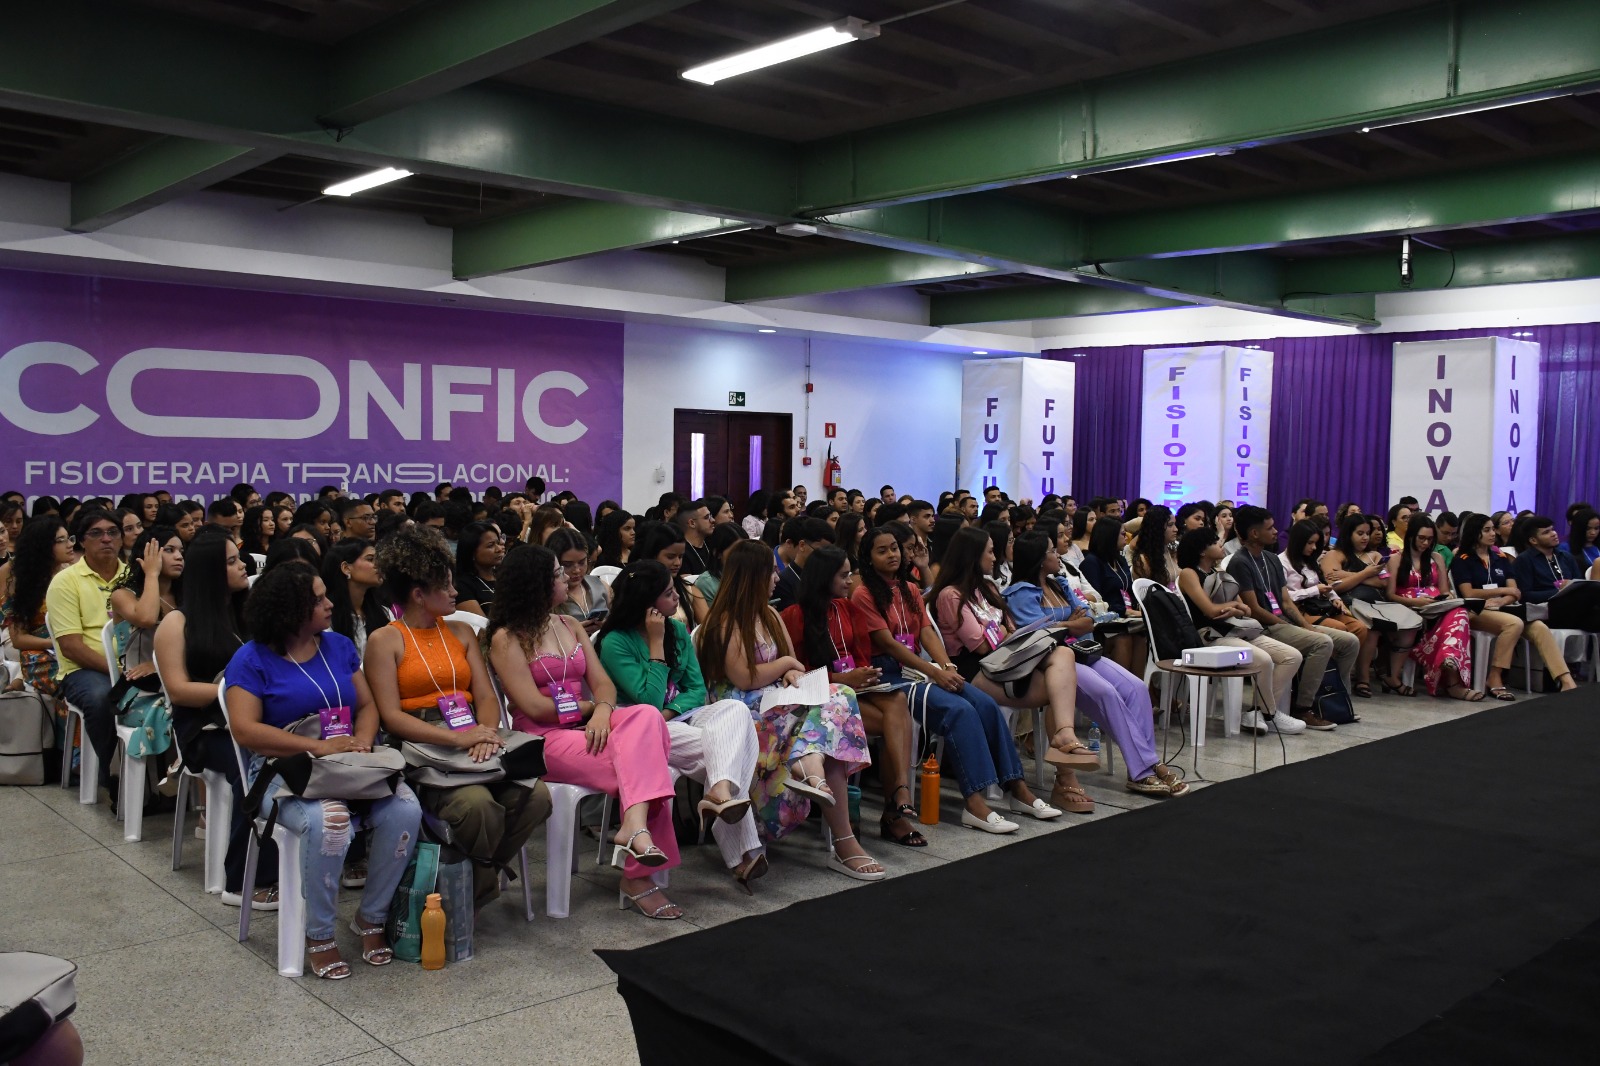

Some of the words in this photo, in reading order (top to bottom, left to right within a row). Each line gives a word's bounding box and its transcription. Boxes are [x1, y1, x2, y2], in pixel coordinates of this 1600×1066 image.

[0, 341, 589, 444] CONFIC
[1424, 355, 1453, 514] INOVA
[1506, 355, 1521, 514] INOVA
[25, 461, 270, 485] FISIOTERAPIA
[282, 462, 570, 484] TRANSLACIONAL:
[1041, 398, 1056, 496] FUTU
